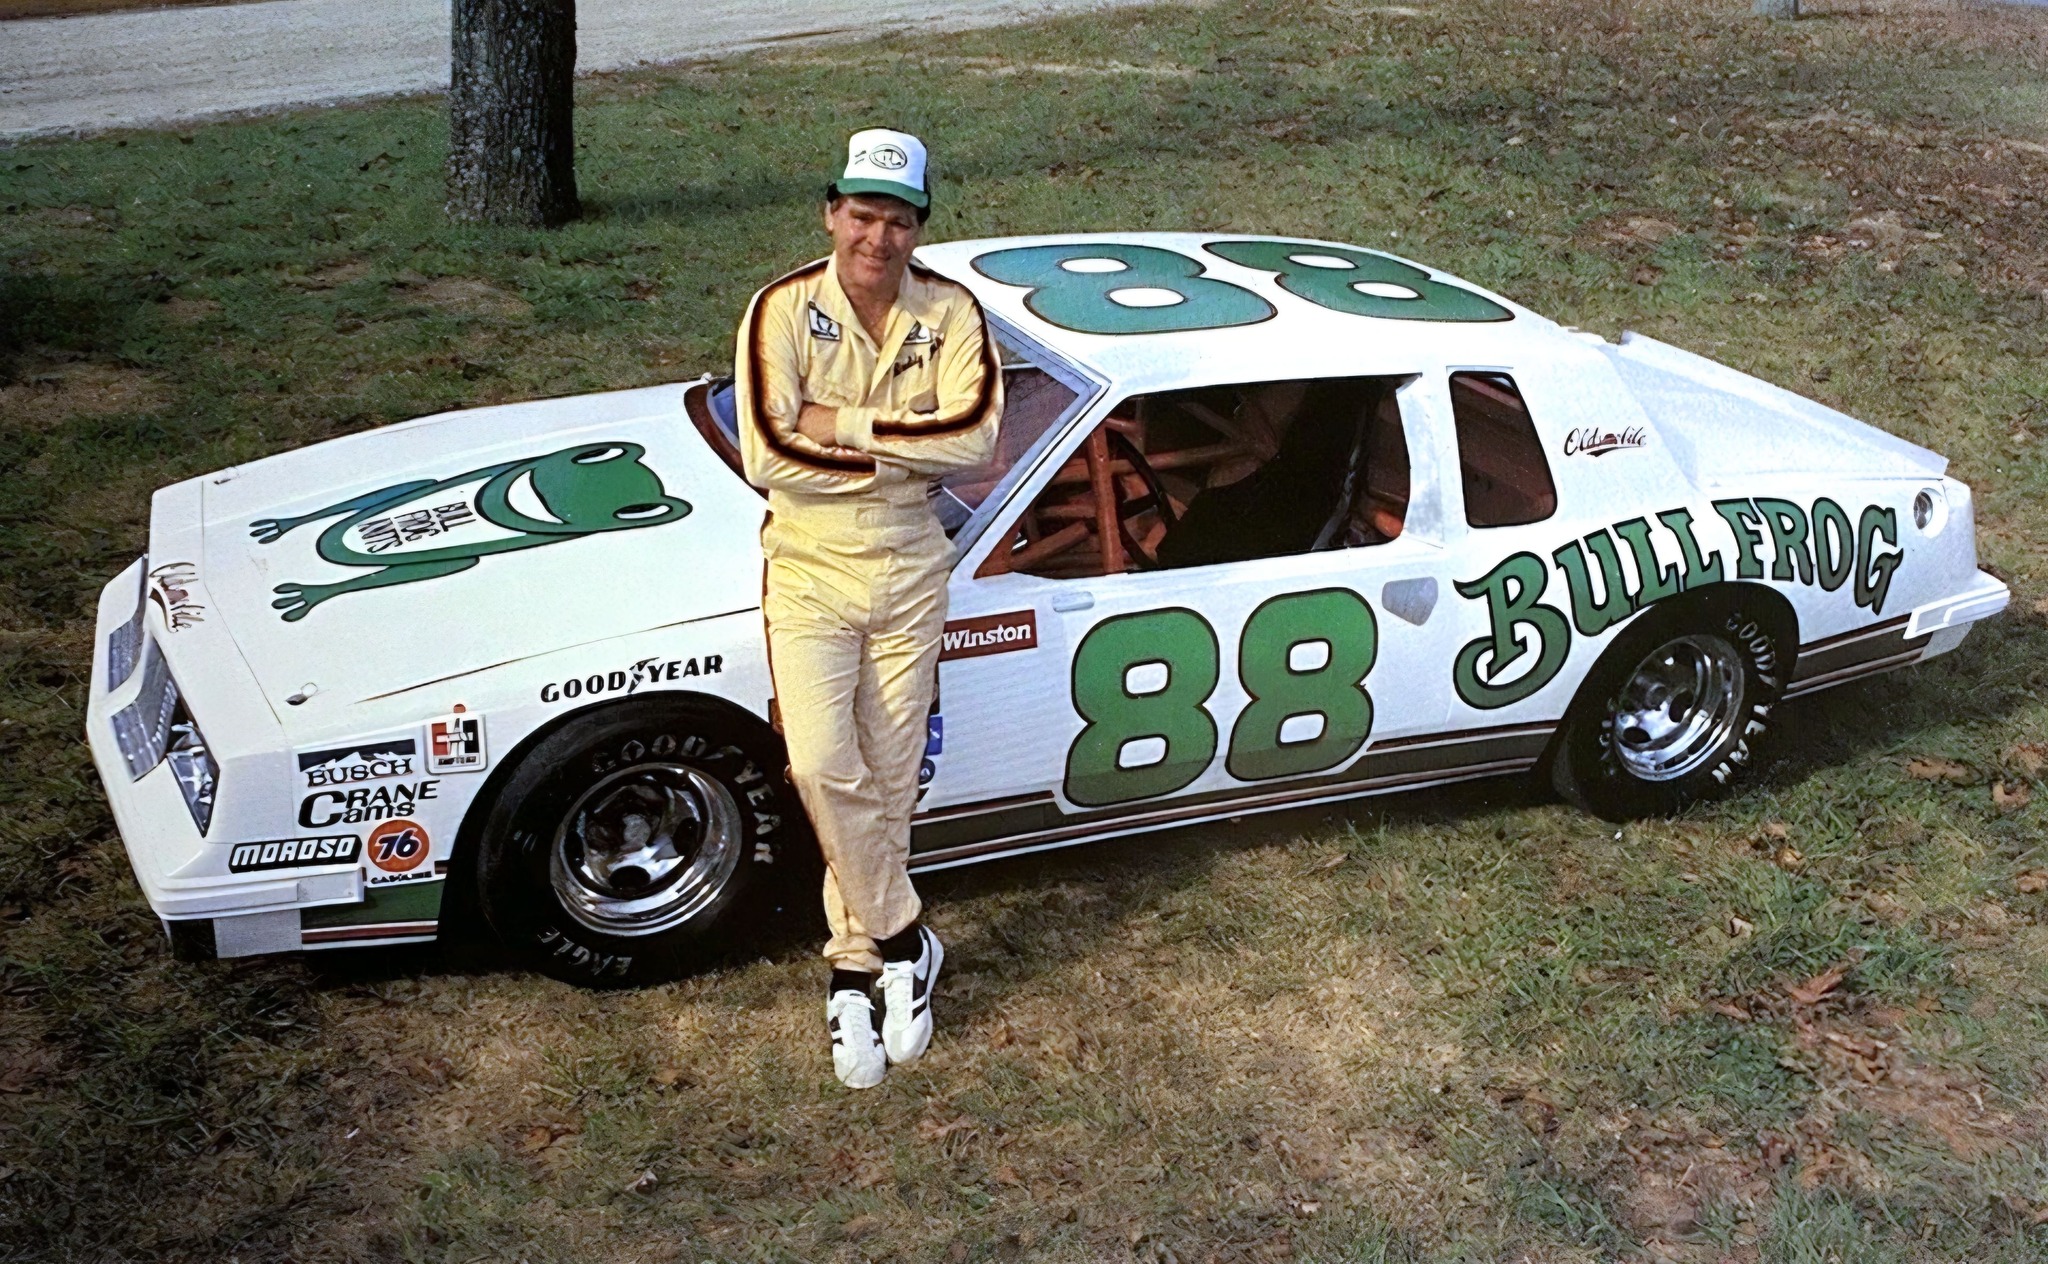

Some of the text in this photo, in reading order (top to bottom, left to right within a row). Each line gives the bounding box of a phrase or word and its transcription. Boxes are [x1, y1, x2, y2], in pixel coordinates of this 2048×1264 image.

[970, 242, 1515, 335] 88
[1453, 497, 1903, 710] BULL FROG
[943, 624, 1031, 651] Winston
[1063, 586, 1379, 808] 88
[306, 757, 414, 788] BUSCH
[231, 837, 356, 867] MOROSO
[374, 827, 422, 864] 76
[537, 925, 633, 976] EAGLE
